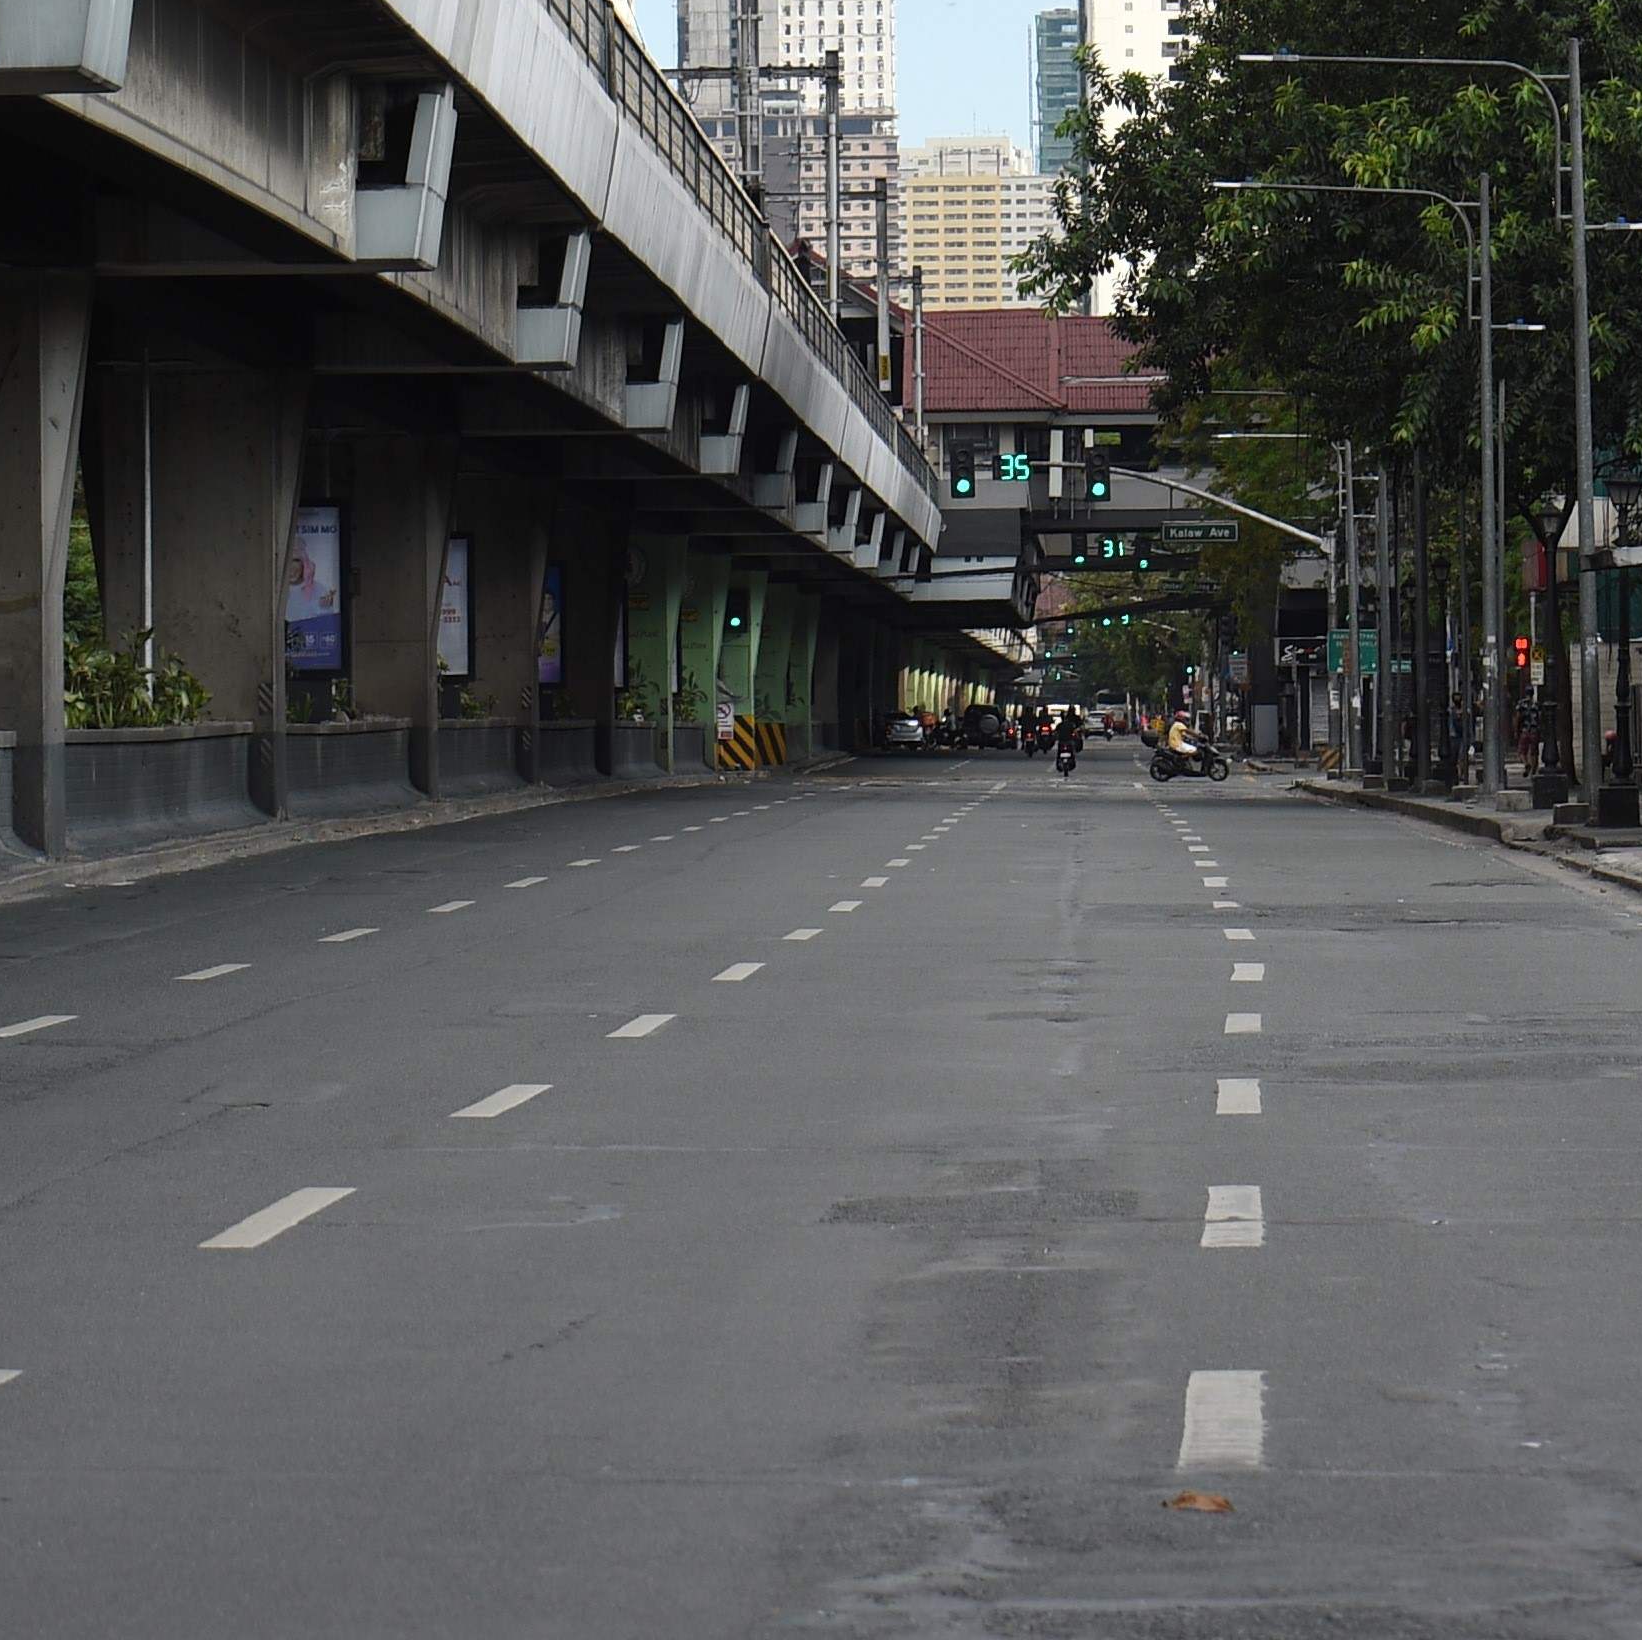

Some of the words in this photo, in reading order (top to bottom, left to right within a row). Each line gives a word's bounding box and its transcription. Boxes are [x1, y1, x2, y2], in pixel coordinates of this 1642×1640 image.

[1000, 454, 1030, 480] 35
[1169, 527, 1203, 538] Kalaw
[1209, 527, 1230, 537] Ave
[1103, 539, 1124, 558] 31
